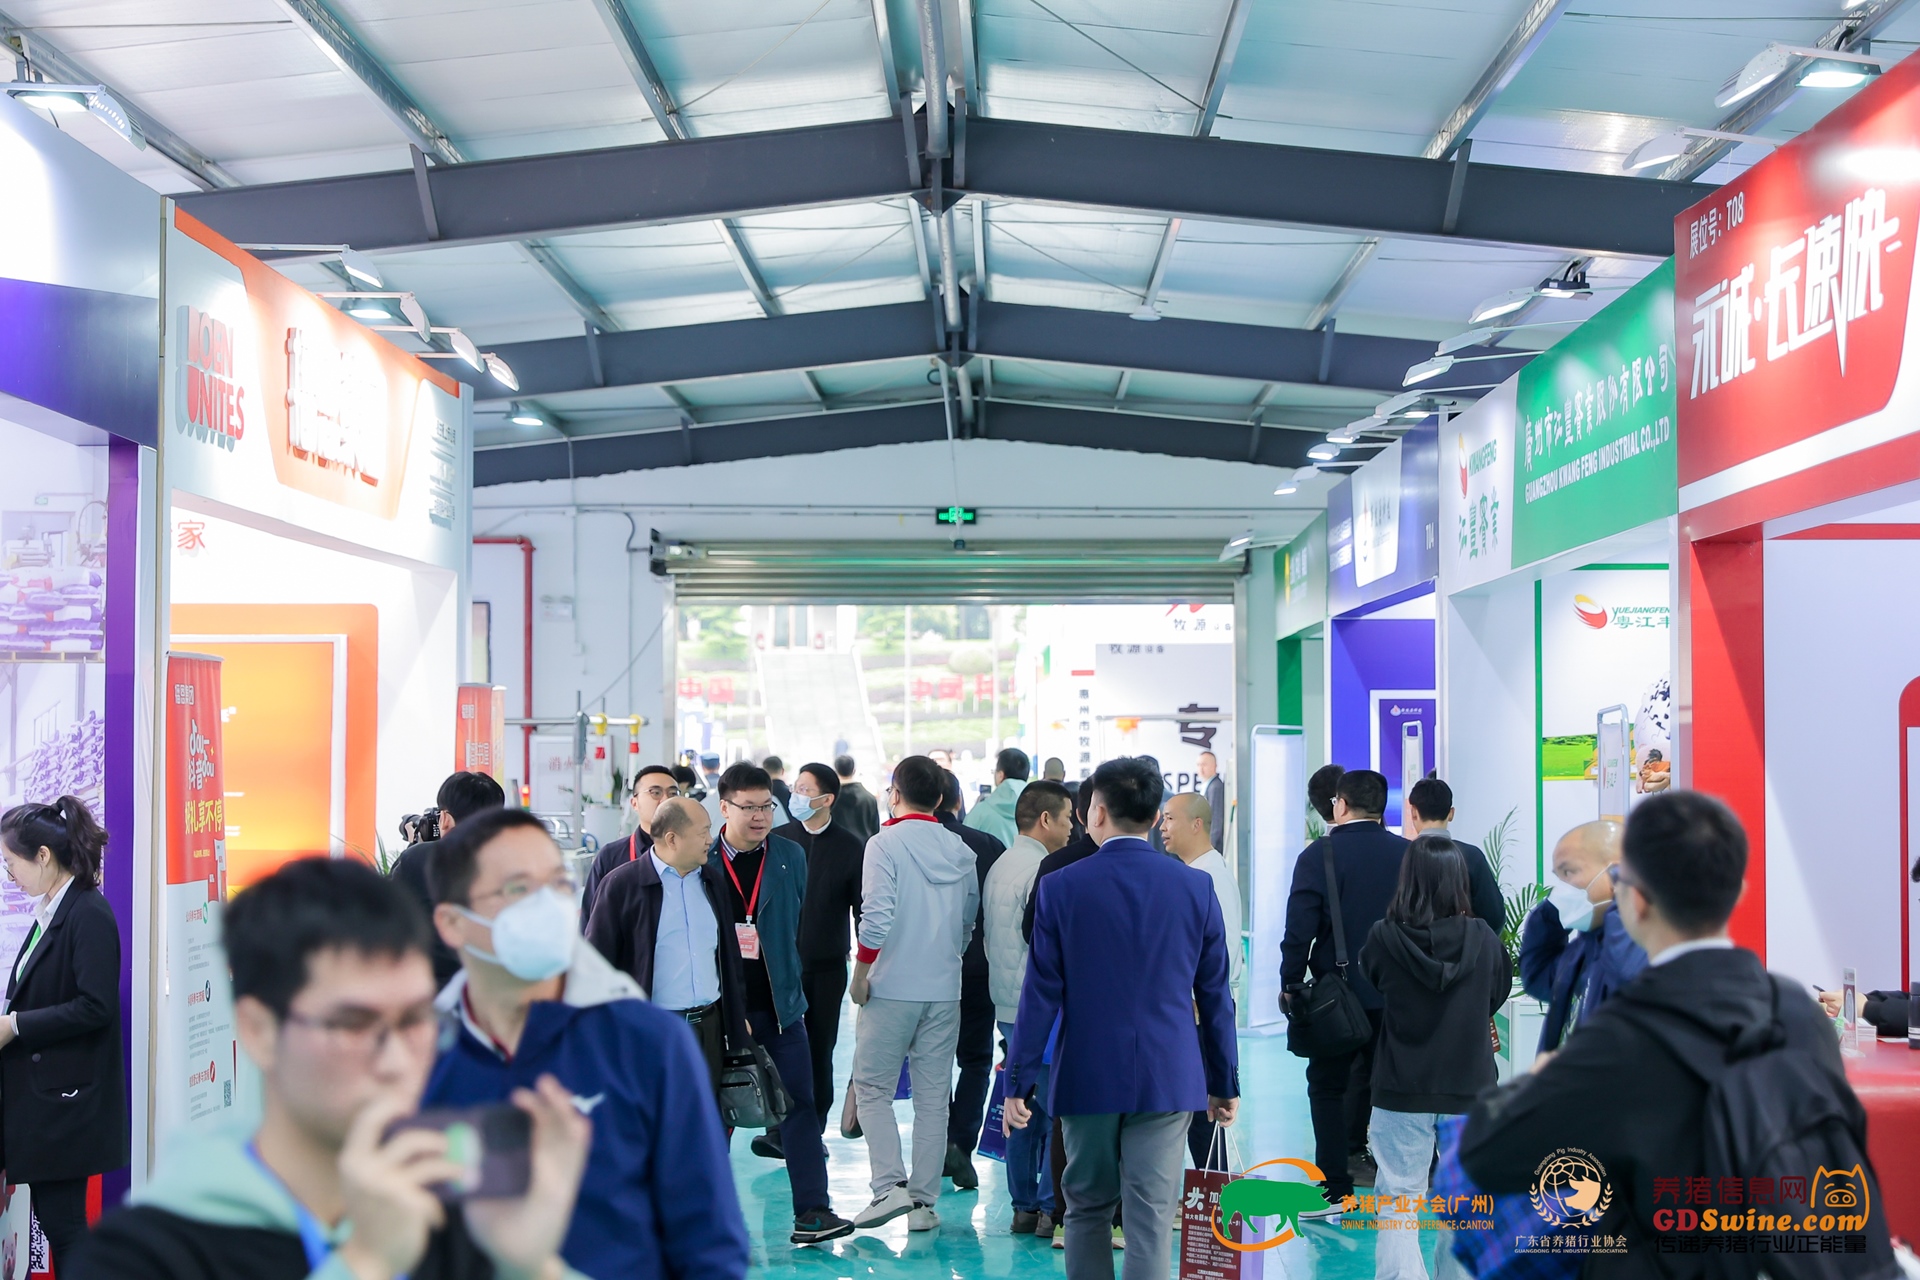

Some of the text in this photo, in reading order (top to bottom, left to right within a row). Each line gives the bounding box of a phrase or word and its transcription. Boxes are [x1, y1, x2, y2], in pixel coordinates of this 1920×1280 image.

[185, 364, 245, 441] UNITES
[1525, 469, 1559, 504] GUANGZHOU
[1559, 459, 1580, 489] KWANG
[1581, 450, 1598, 479] FENG
[1599, 430, 1640, 471] INDUSTRIAL
